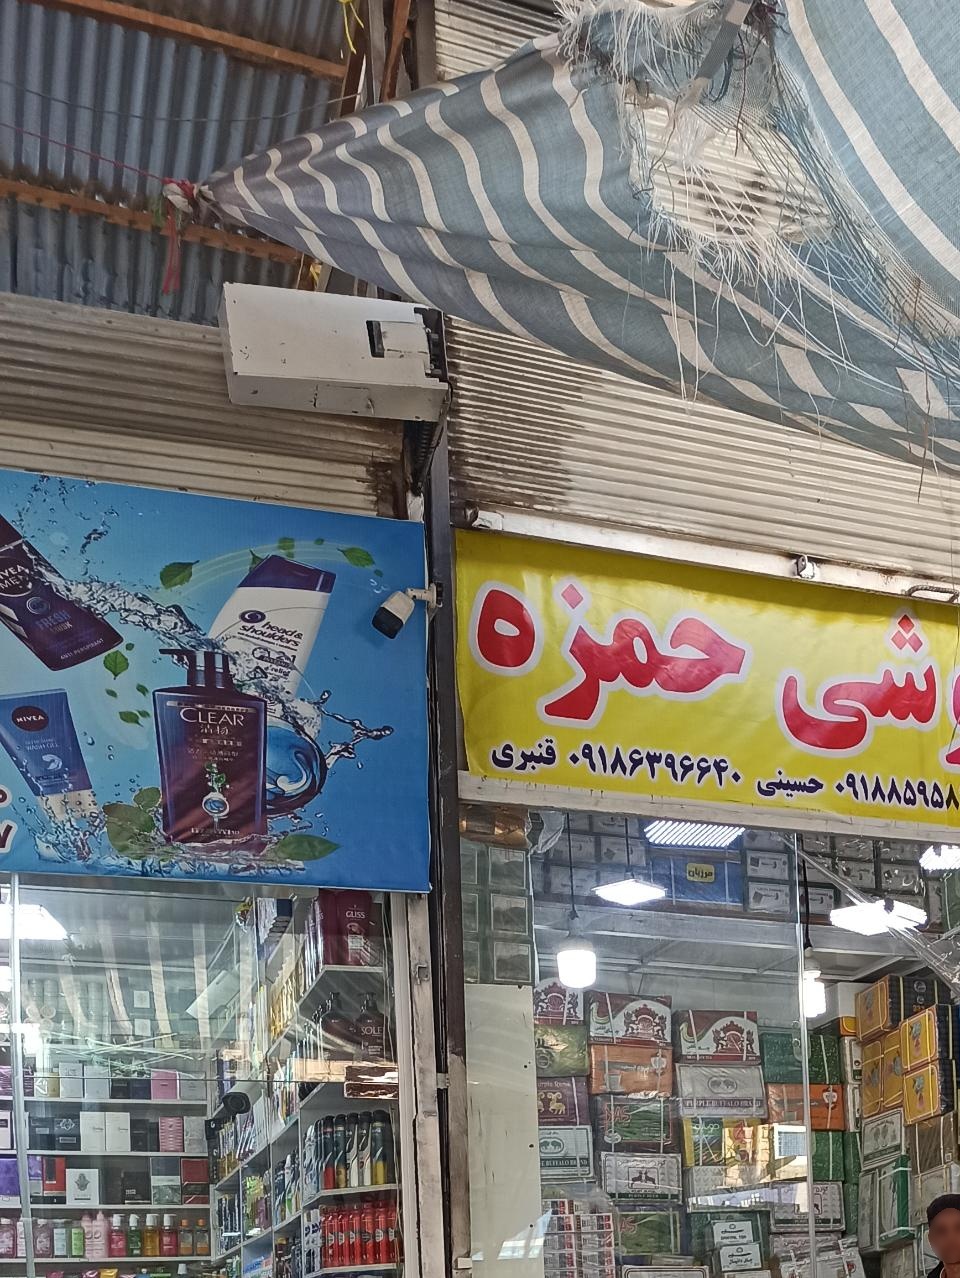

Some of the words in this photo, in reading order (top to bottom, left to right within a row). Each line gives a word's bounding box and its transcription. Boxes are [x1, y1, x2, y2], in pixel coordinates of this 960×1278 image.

[476, 583, 746, 721] حمزه
[16, 714, 45, 723] NIVEA
[180, 707, 245, 726] CLEAR
[491, 738, 557, 771] قنبری
[568, 743, 742, 786] ۰۹۱۸۶۳۹۶۶۴۰
[757, 769, 824, 798] حسینی
